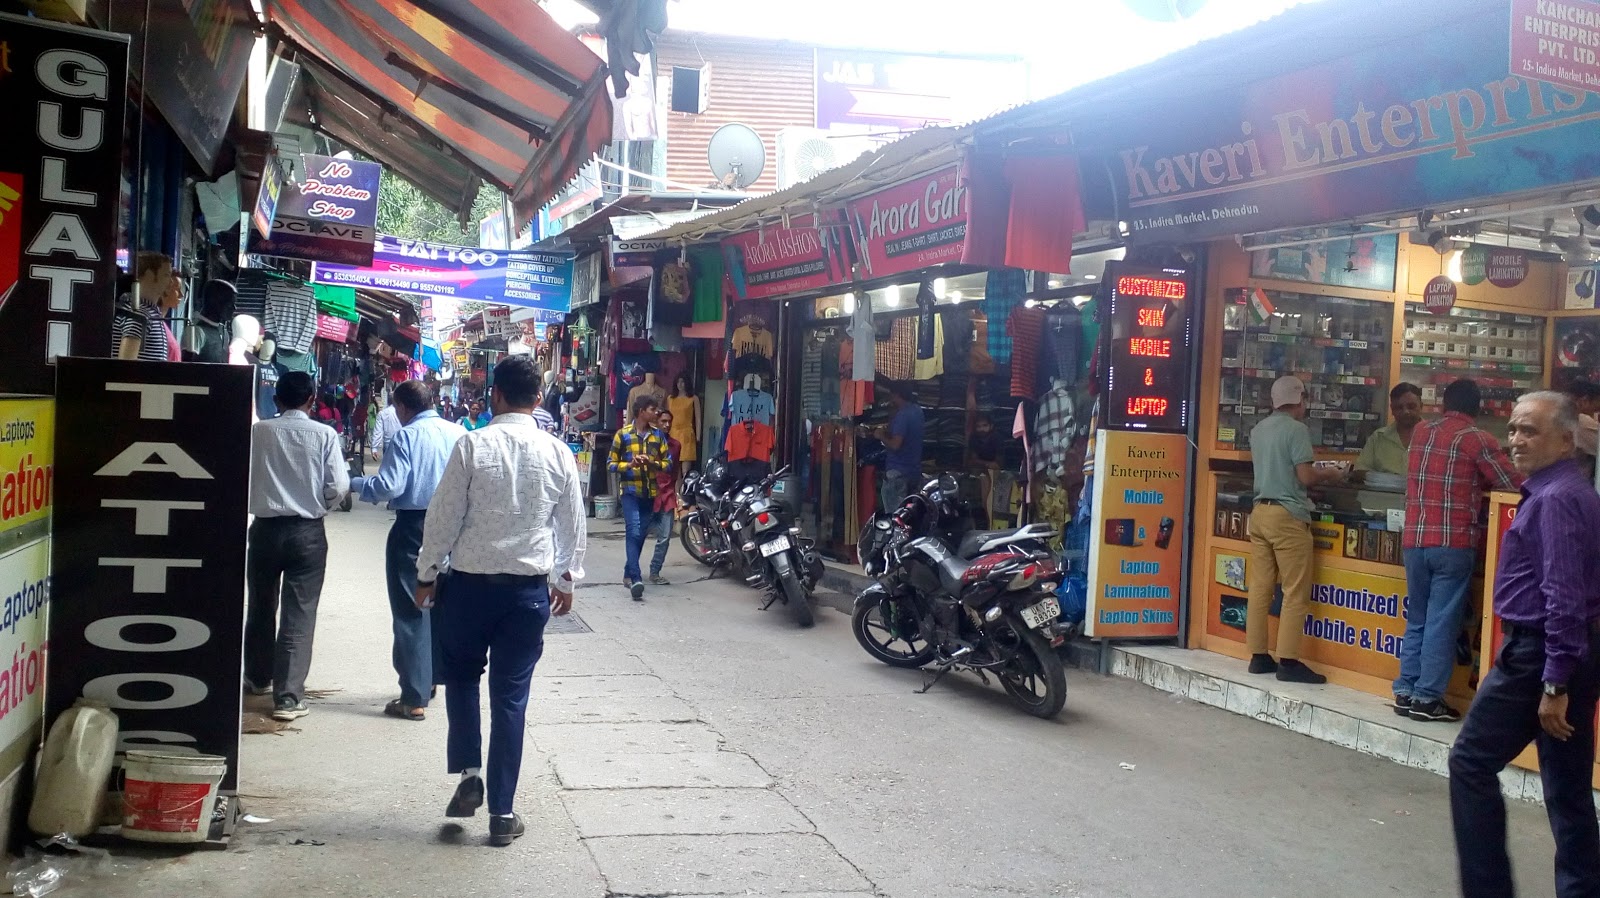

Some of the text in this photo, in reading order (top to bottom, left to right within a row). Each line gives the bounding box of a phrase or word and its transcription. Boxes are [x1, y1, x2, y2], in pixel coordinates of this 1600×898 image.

[1539, 38, 1600, 67] PVT. LTD.
[1536, 62, 1556, 76] Indira
[1119, 76, 1599, 199] Kaveri Enterpris
[319, 162, 352, 178] No
[300, 180, 371, 201] Problem
[25, 48, 108, 365] GULATI
[308, 201, 355, 220] Shop
[869, 181, 968, 240] Arora Gar
[1149, 214, 1174, 229] Indira
[1212, 204, 1259, 220] Dehradun
[397, 239, 498, 266] TATTOO
[618, 242, 665, 250] OCTAV
[528, 263, 547, 273] COVER
[1492, 255, 1522, 266] MOBILE
[506, 271, 541, 283] CONCEPTUAL
[504, 290, 541, 301] ACCESSORIES
[1118, 277, 1187, 299] CUSTOMIZED
[1429, 282, 1452, 294] LAPTOP
[1138, 308, 1164, 327] SKIN
[1130, 338, 1170, 358] MOBILE
[1144, 368, 1153, 386] &
[1127, 397, 1167, 416] LAPTOP
[1127, 445, 1166, 459] Kaveri
[1110, 464, 1180, 482] Enterprises
[1124, 489, 1164, 504] Mobile
[1138, 526, 1146, 540] &
[1120, 559, 1160, 575] Laptop
[0, 577, 50, 634] aptops
[1311, 583, 1398, 618] ustomized
[1099, 609, 1174, 625] Laptop Skins
[1360, 629, 1371, 650] &
